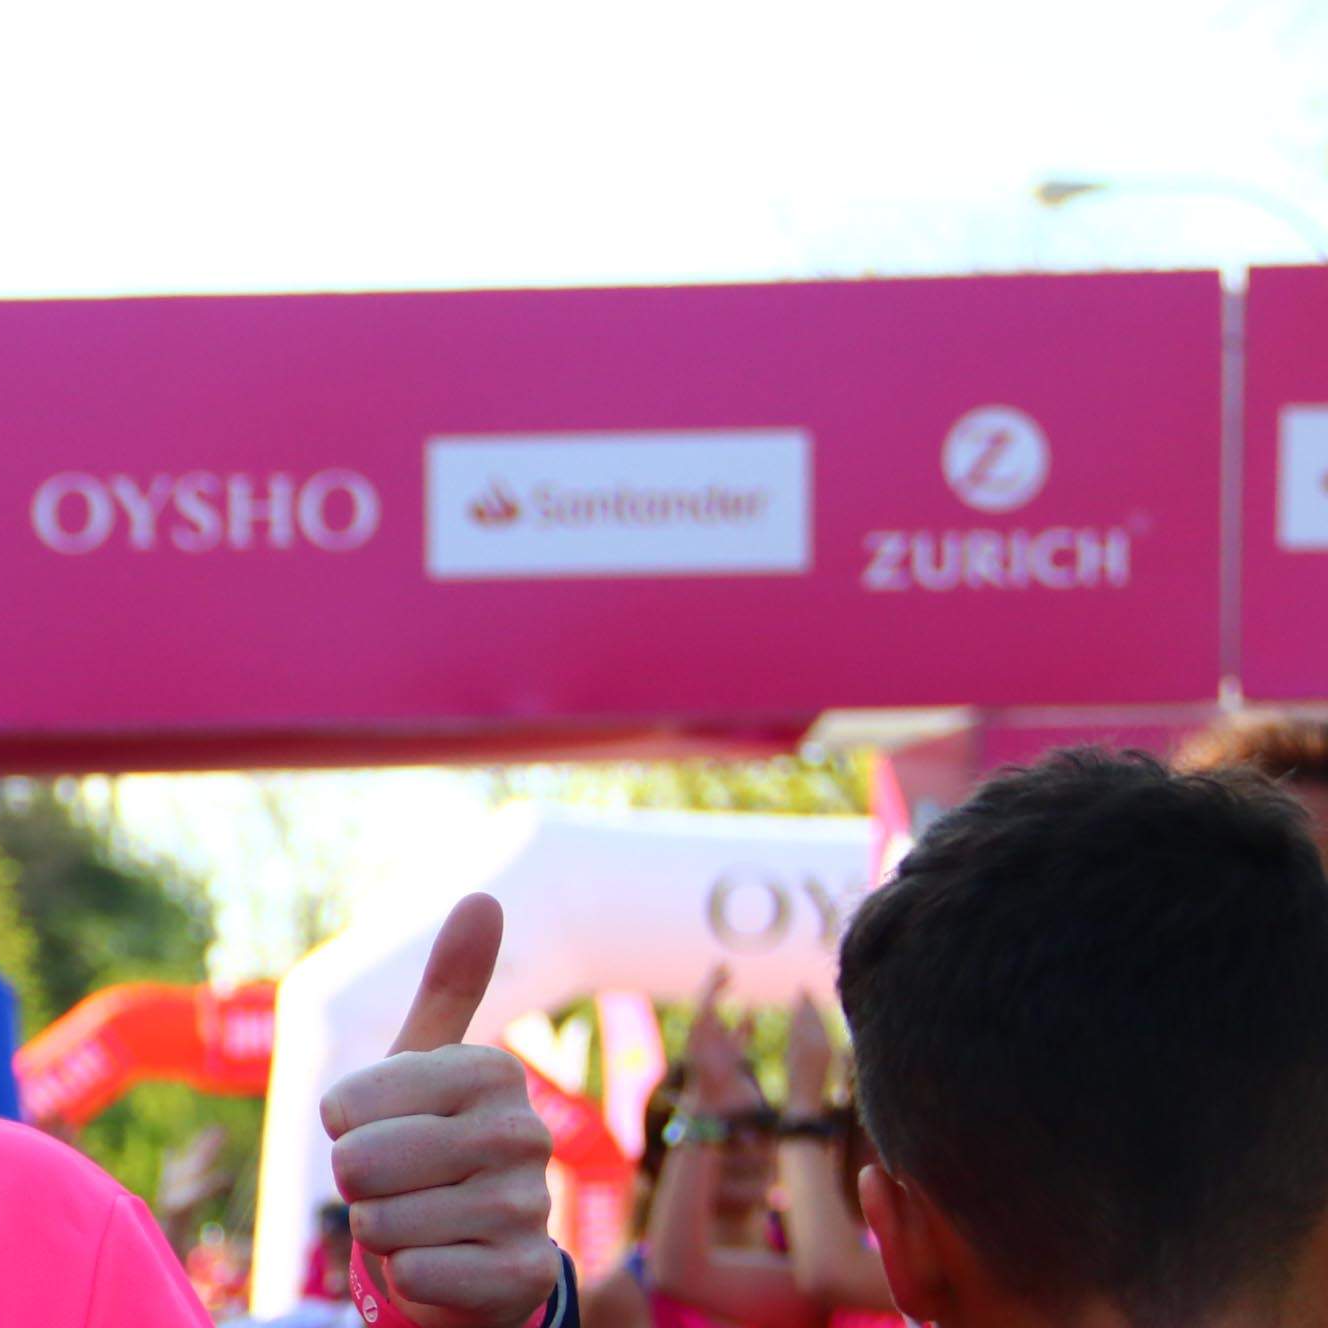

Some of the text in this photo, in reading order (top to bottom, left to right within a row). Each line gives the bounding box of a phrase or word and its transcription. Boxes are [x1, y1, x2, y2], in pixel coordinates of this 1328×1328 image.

[31, 468, 382, 556] OYSHO
[531, 480, 770, 530] Santander
[860, 527, 1131, 593] ZURICH
